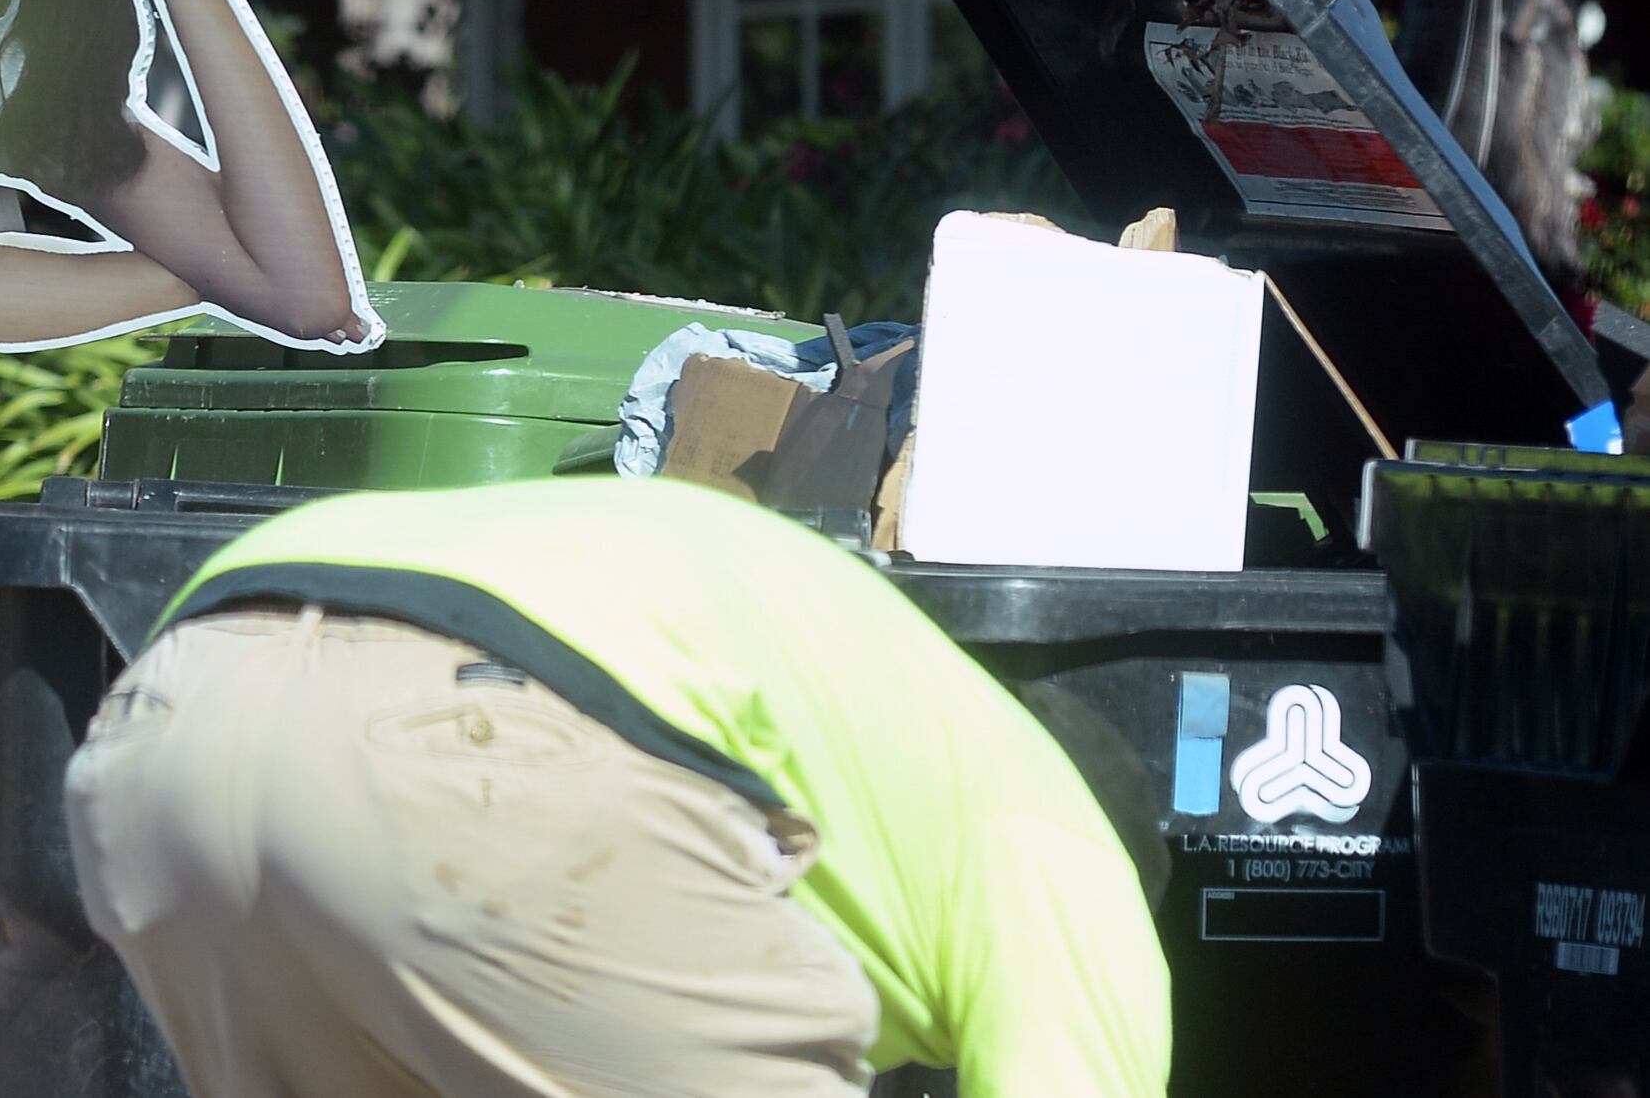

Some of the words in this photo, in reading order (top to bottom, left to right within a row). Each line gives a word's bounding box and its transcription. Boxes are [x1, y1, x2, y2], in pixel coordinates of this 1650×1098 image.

[1228, 860, 1236, 877] 1
[1243, 859, 1291, 881] (800)
[1295, 860, 1375, 879] 773-CITY
